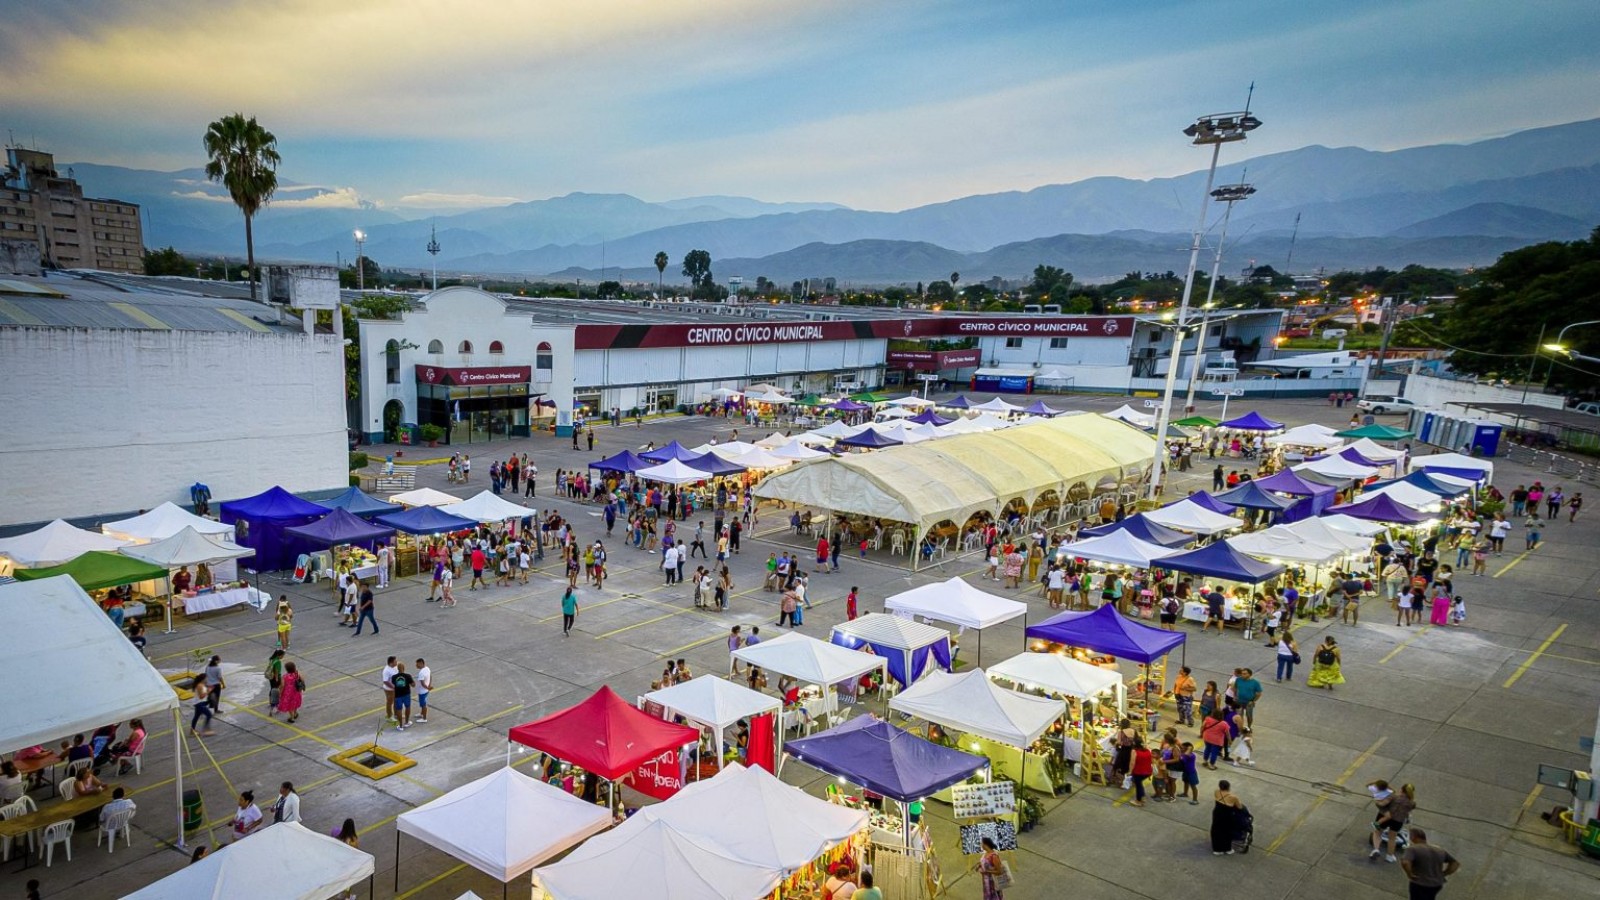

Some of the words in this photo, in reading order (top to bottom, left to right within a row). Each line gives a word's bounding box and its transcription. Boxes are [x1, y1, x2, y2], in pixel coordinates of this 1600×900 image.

[959, 323, 996, 331] CENTRO
[998, 321, 1031, 331] CÍVICO
[1033, 323, 1089, 331] MUNICIPAL
[687, 328, 732, 343] CENTRO
[734, 324, 771, 341] CÍVICO
[773, 326, 823, 340] MUNICIPAL
